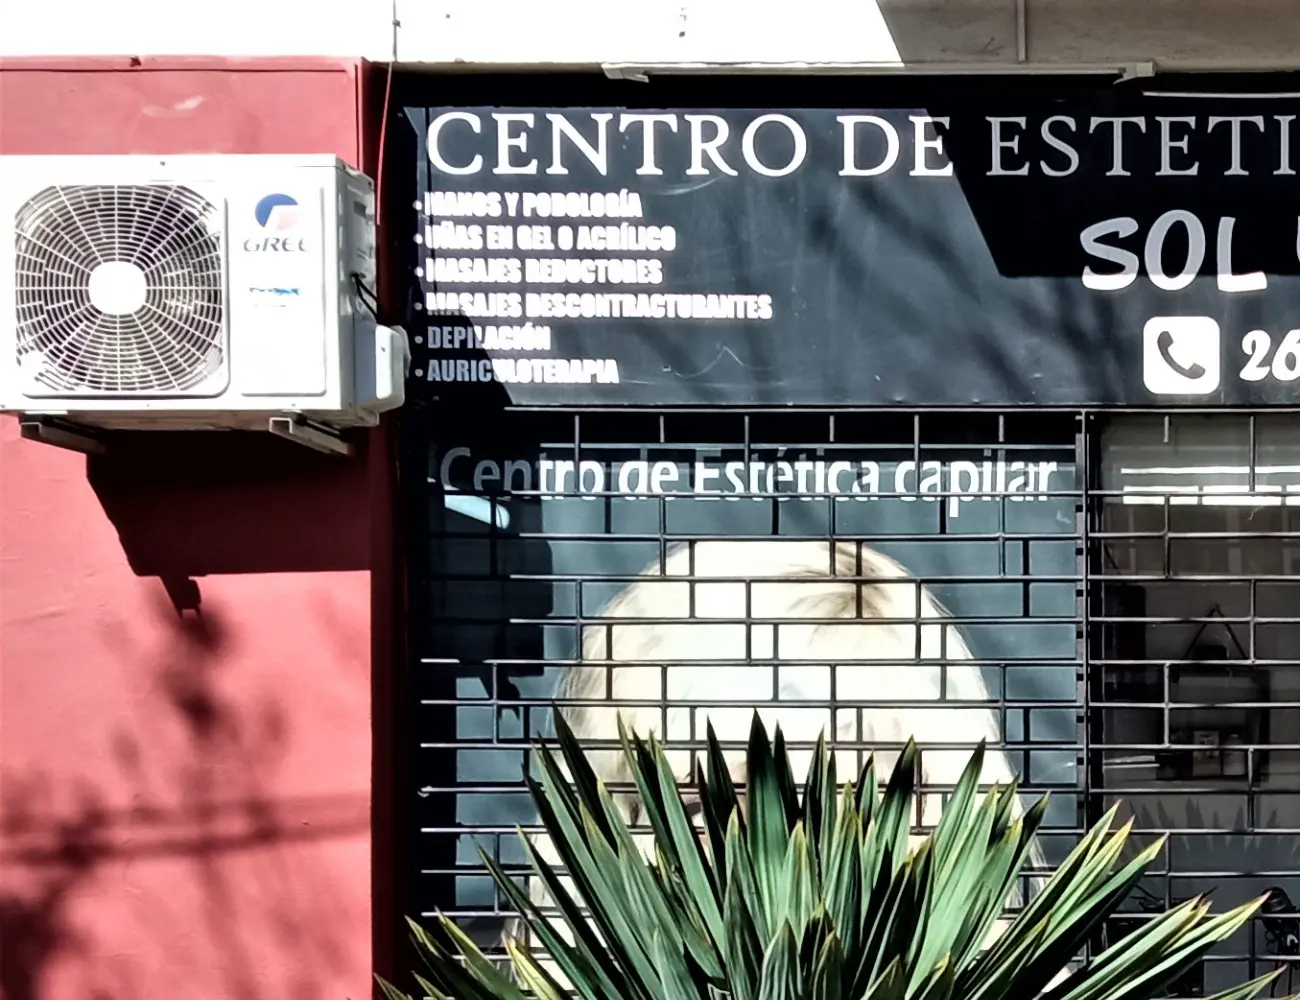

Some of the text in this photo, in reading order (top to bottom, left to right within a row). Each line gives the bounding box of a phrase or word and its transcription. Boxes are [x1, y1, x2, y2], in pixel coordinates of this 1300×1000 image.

[427, 111, 808, 178] CENTRO
[836, 114, 954, 178] DE
[424, 188, 644, 219] MANOS Y PODOLOGÍA
[425, 220, 677, 251] UÑAS EN GEL O ACRÍLICO
[1080, 208, 1268, 293] SOL
[425, 257, 664, 285] MASAJES REDUCTORES
[425, 292, 774, 320] MASAJES DESCONTRACTURANTES
[427, 321, 552, 351] DEPILACIÓN
[426, 358, 621, 385] AURICULOTERAPIA
[440, 446, 1058, 518] Centro de Estética capilar
